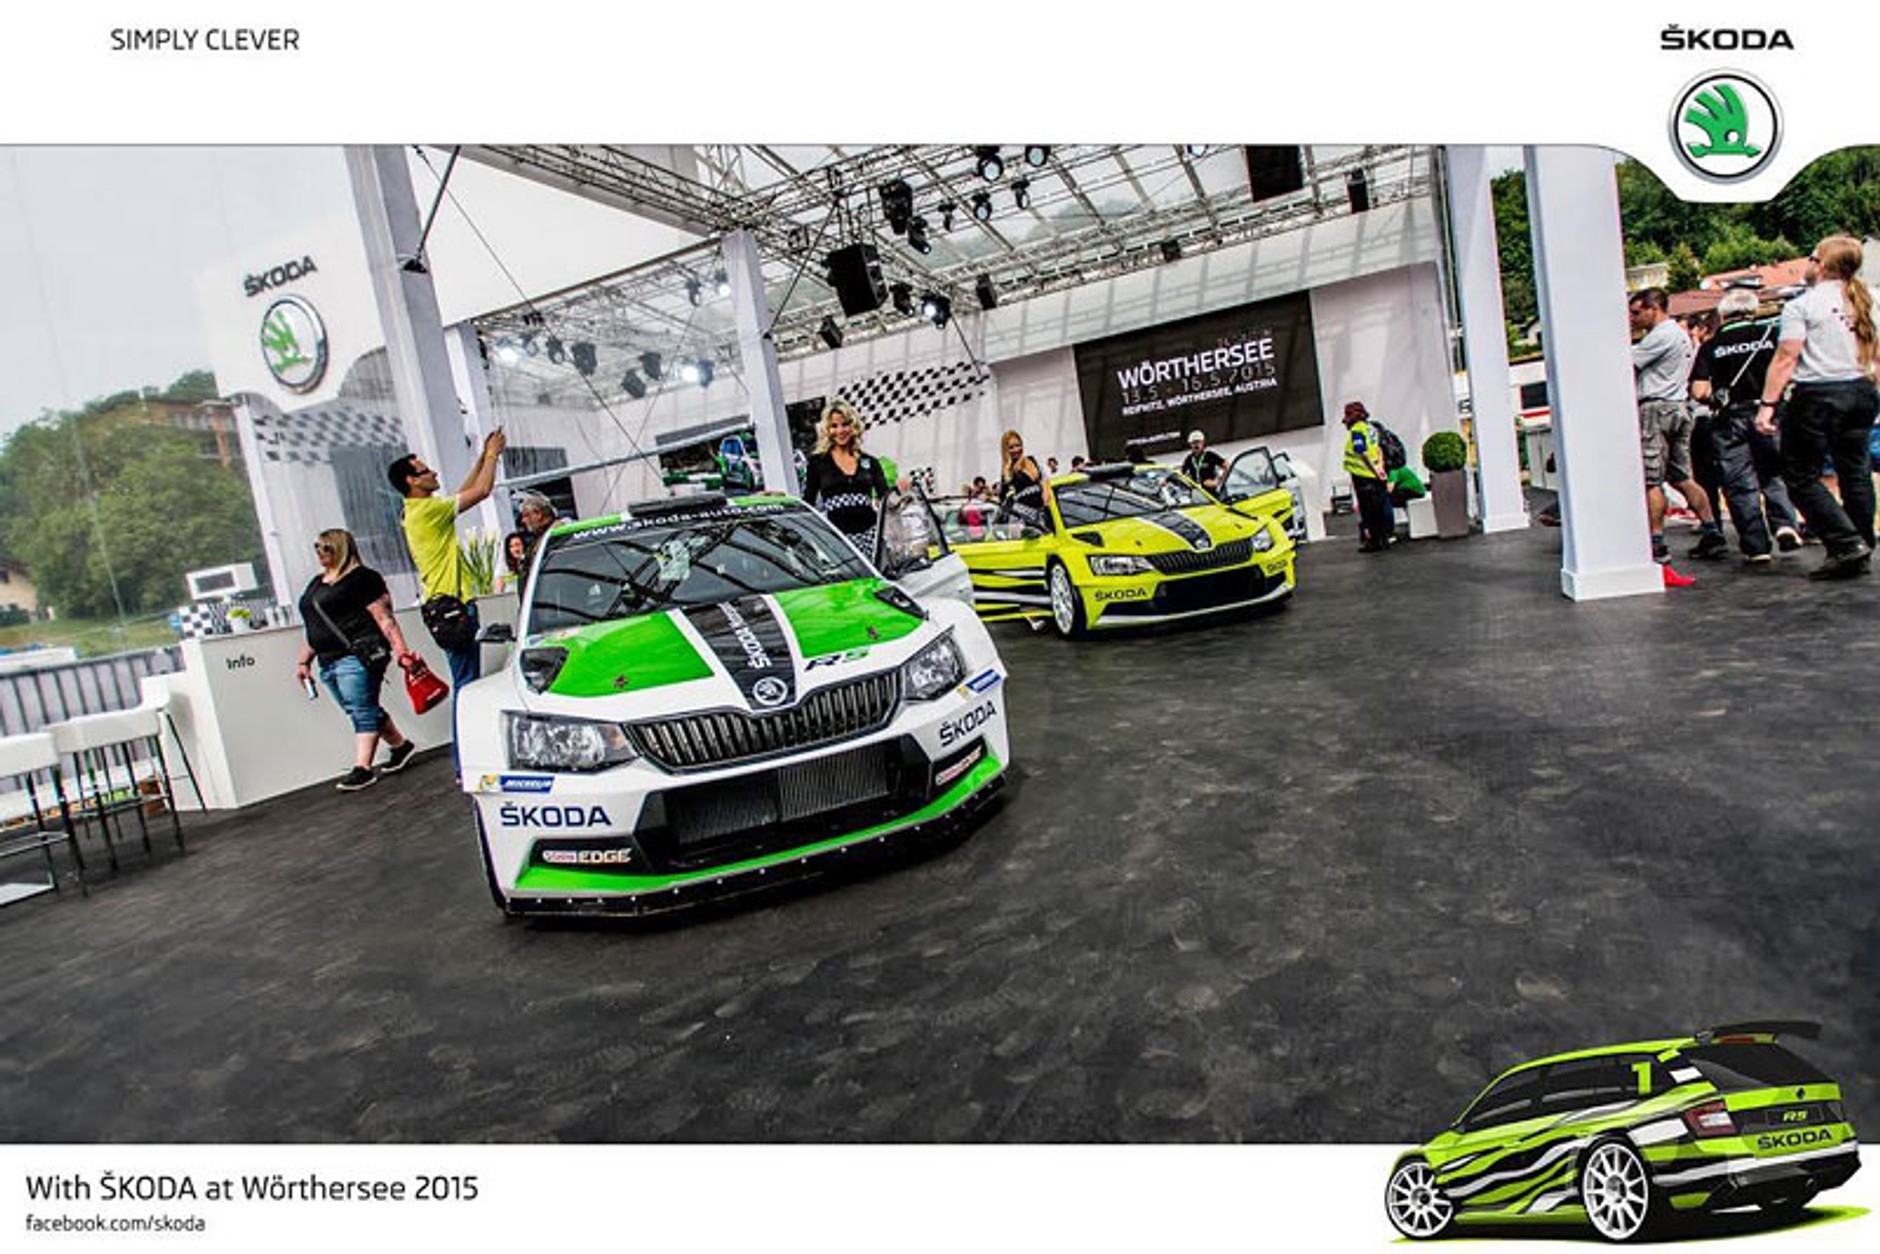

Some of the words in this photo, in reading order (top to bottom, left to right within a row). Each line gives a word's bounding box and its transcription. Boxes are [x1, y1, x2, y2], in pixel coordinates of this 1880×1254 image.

[244, 255, 318, 297] ŠKODA
[1117, 338, 1275, 389] WÖRTHERSEE
[226, 655, 255, 670] Info
[804, 649, 869, 672] RS
[939, 700, 997, 748] ŠKODA
[501, 803, 611, 827] ŠKODA
[578, 848, 632, 864] EDGE
